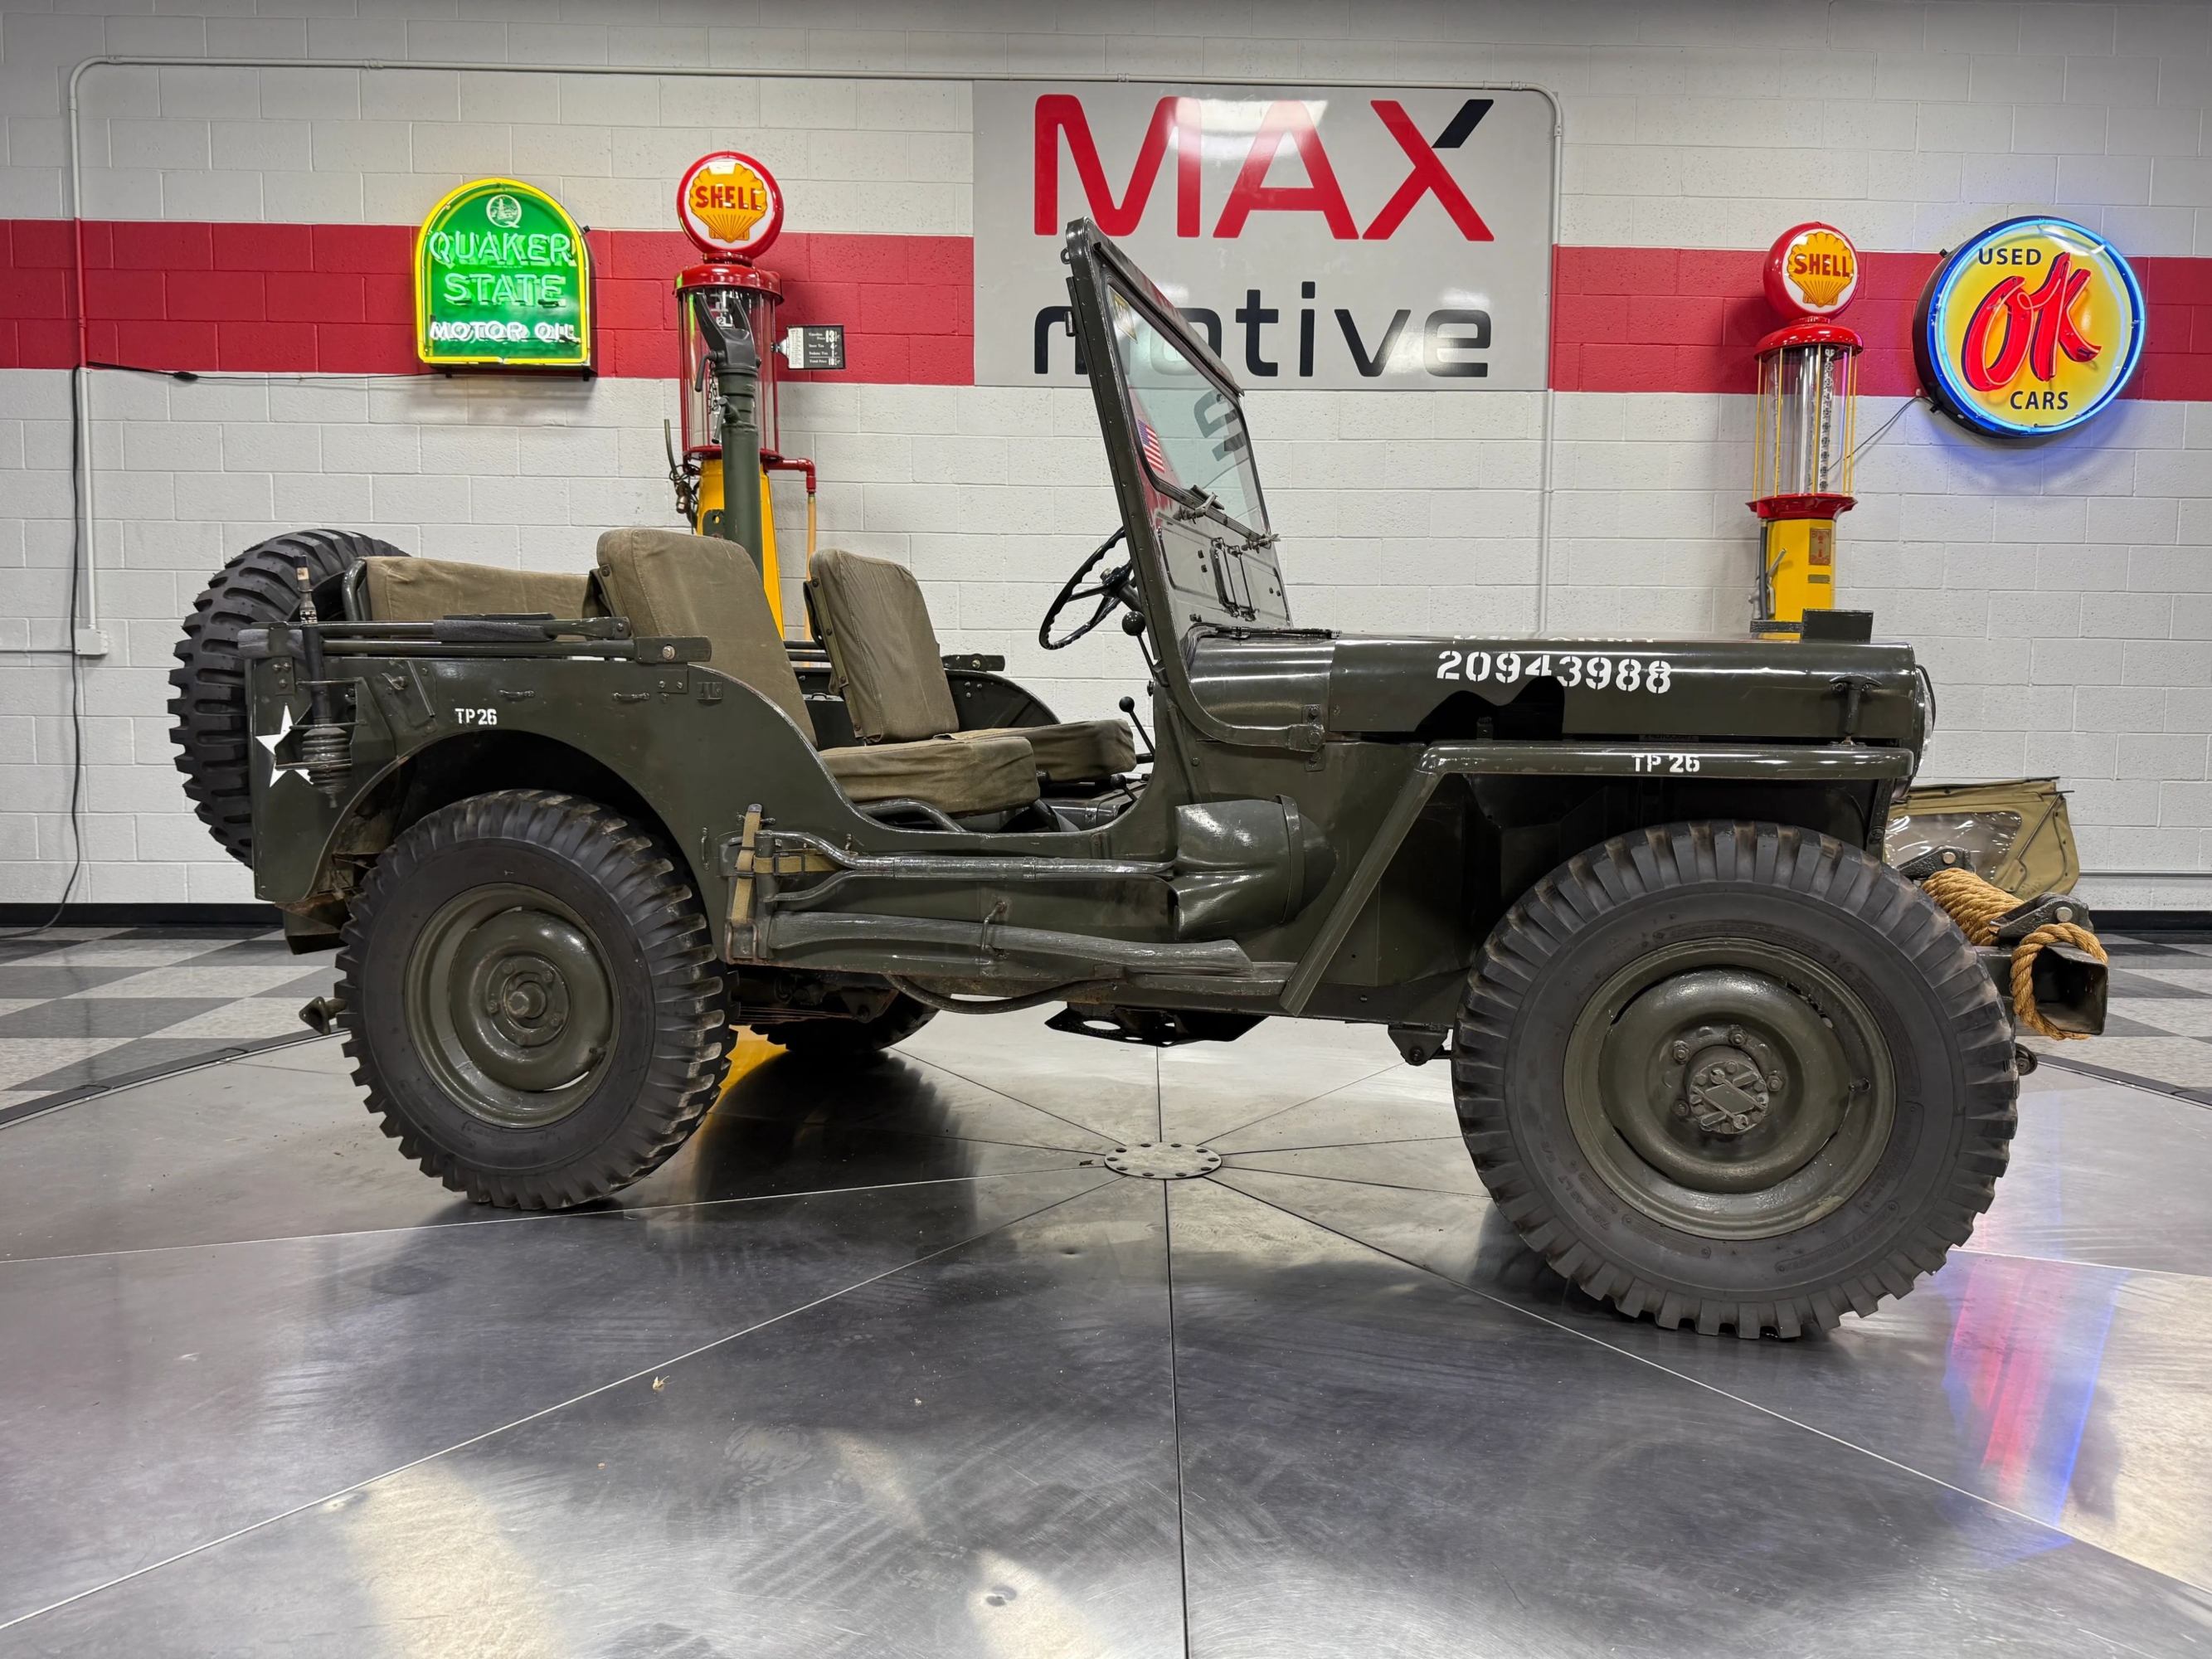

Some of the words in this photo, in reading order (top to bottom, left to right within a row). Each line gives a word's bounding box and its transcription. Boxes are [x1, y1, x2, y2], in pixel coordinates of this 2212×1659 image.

[1034, 94, 1495, 241] MAX
[695, 185, 762, 212] SHELL
[429, 230, 576, 268] QUAKER
[1978, 247, 2042, 265] USED
[1793, 253, 1850, 278] SHELL
[444, 272, 566, 307] STATE
[430, 320, 529, 343] MOTOR
[534, 321, 580, 343] OIL
[1961, 251, 2103, 392] OK
[2010, 391, 2069, 411] CARS
[1437, 650, 1671, 693] 20943988
[1631, 754, 1661, 772] TP
[1669, 754, 1700, 773] 26
